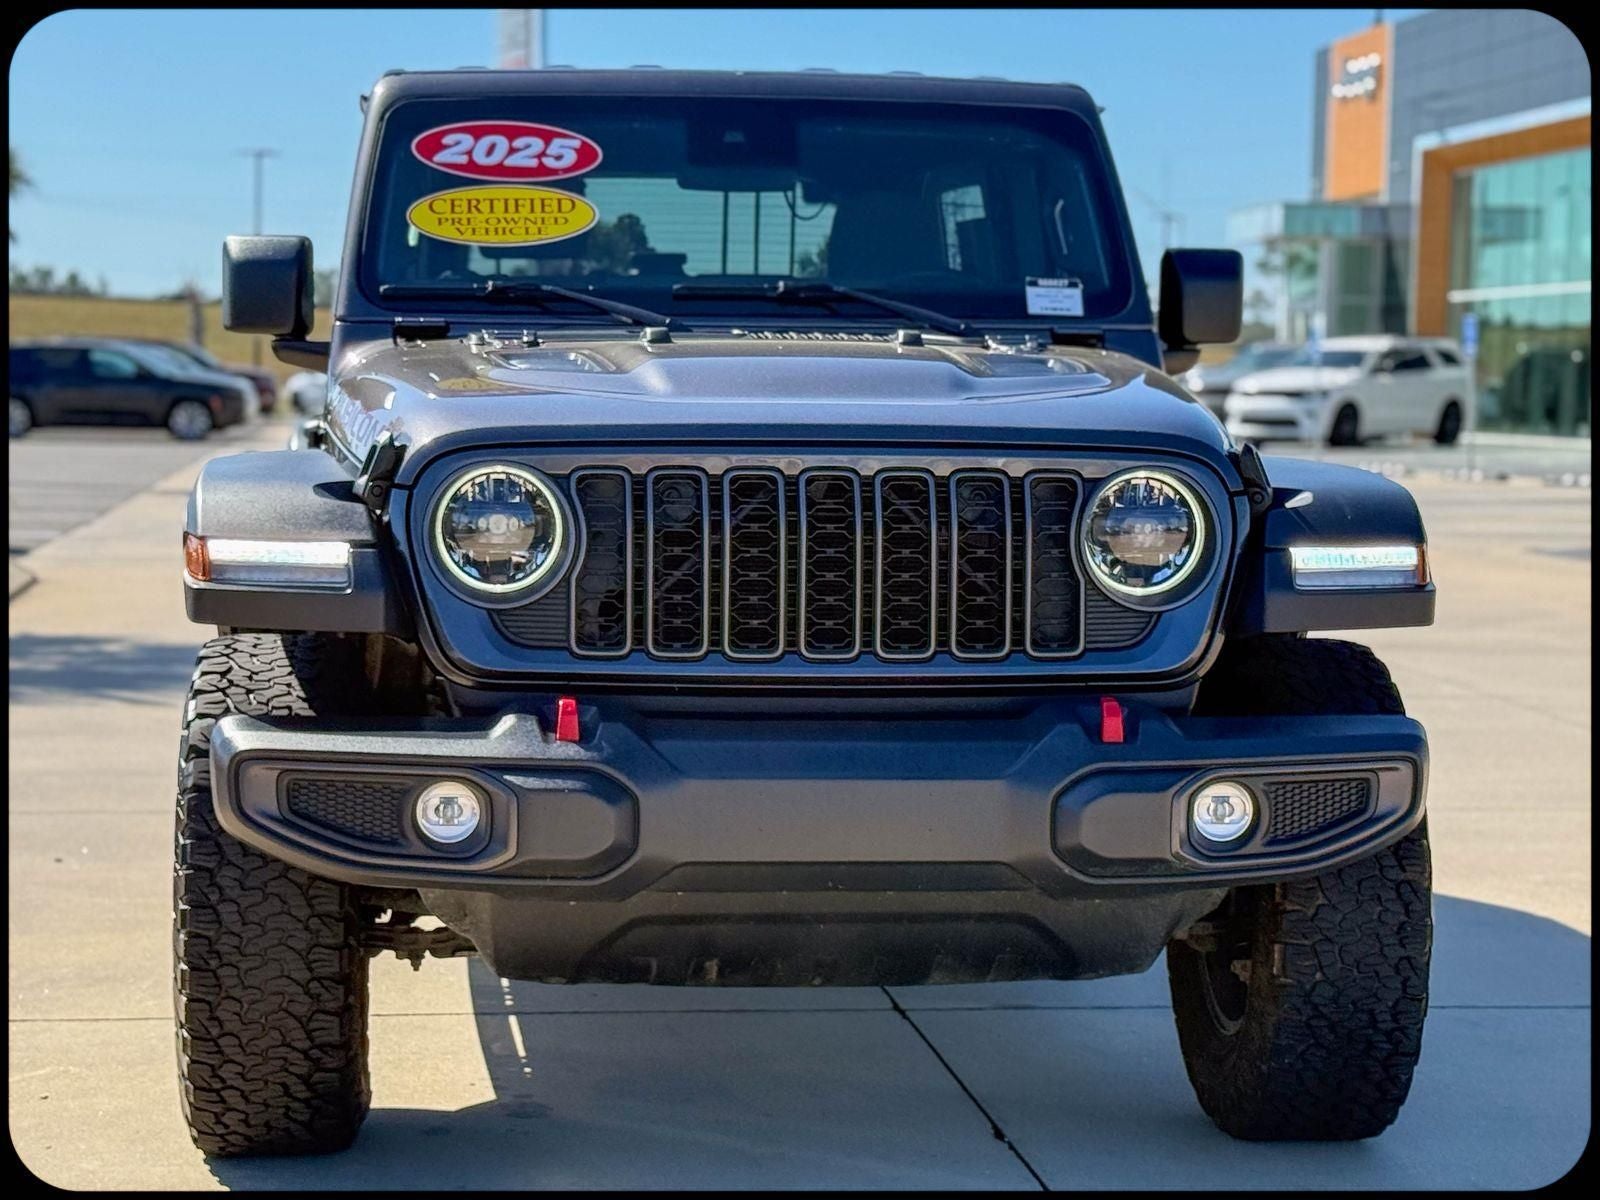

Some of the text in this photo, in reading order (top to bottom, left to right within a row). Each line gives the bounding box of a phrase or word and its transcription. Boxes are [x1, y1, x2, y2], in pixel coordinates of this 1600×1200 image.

[433, 133, 582, 169] 2025
[428, 198, 576, 215] CERTIFIED
[437, 216, 569, 226] PRE-OWNED
[455, 227, 549, 236] VEHICLE
